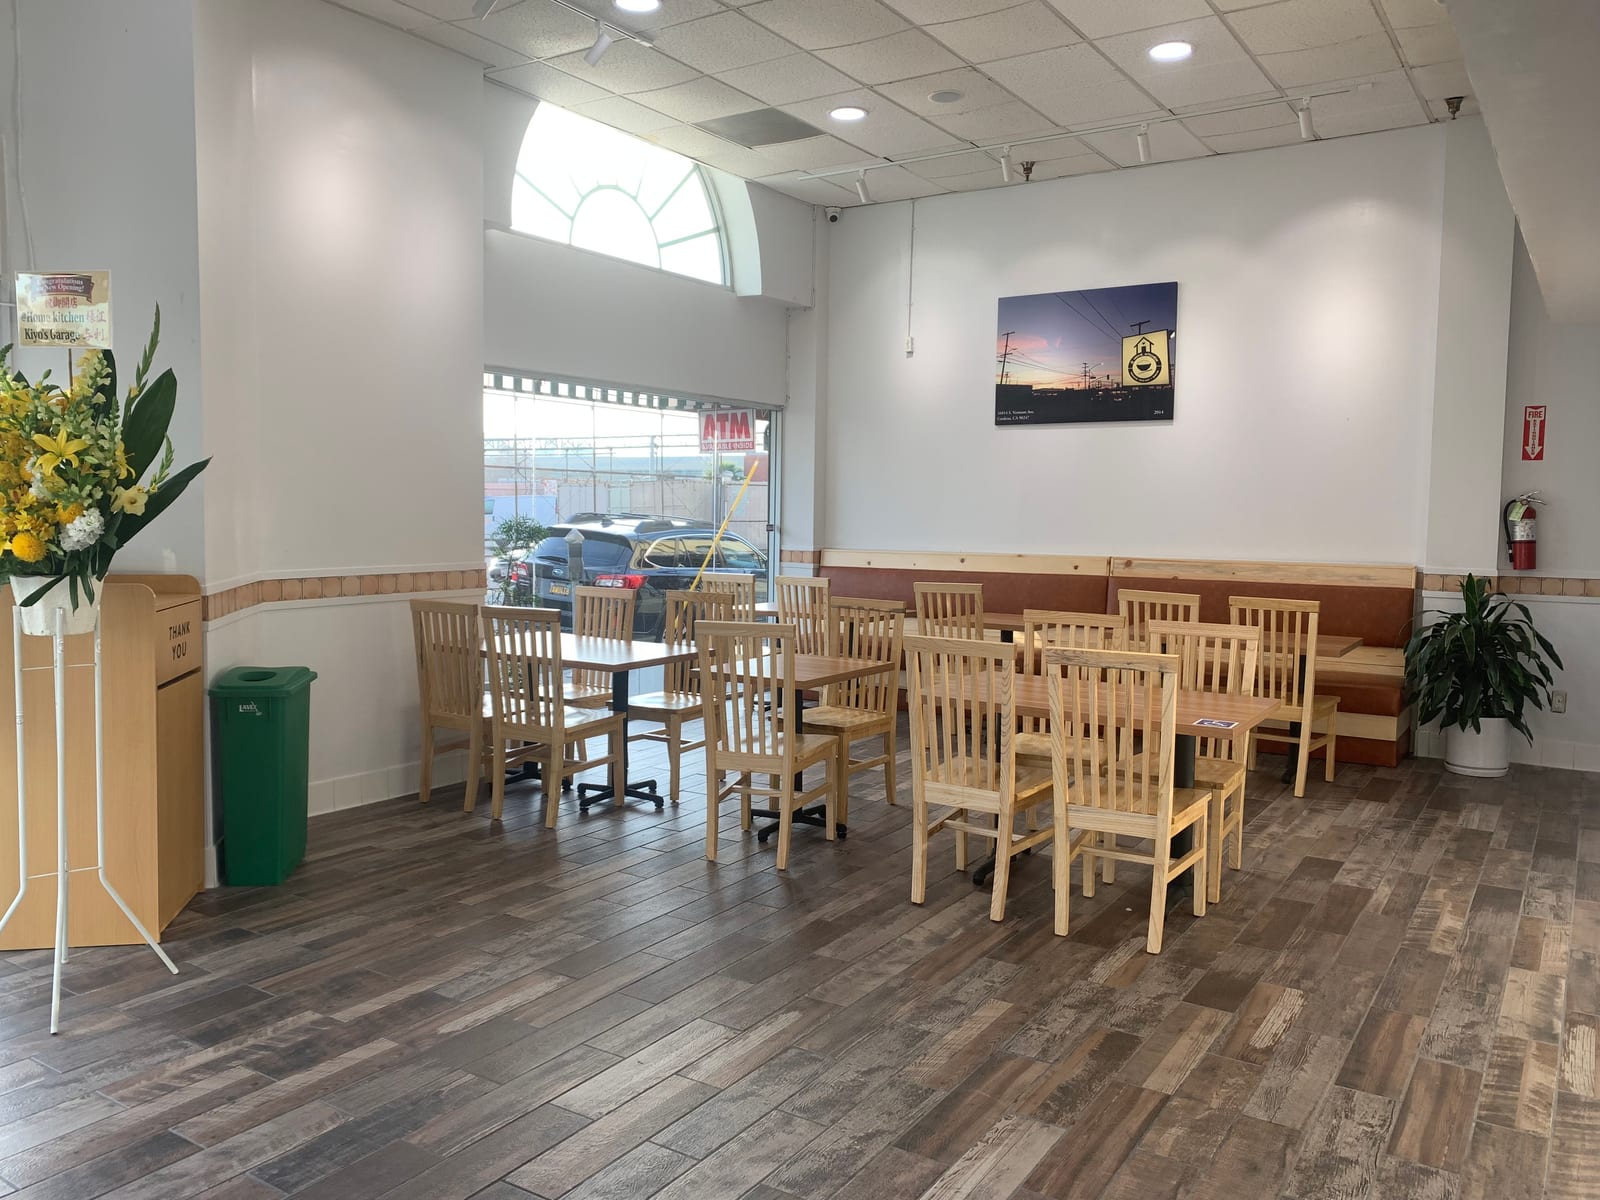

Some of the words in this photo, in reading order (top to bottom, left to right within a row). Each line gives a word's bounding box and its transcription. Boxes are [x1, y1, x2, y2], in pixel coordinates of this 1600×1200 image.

[53, 311, 85, 323] kitchen
[24, 328, 49, 343] Kiyo's
[50, 328, 81, 343] Garage
[1528, 411, 1543, 419] FIRE
[703, 412, 750, 440] ATM
[702, 442, 732, 450] AVAABLE
[732, 441, 753, 449] INSIDE
[169, 621, 191, 640] THANK
[171, 641, 187, 660] YOU
